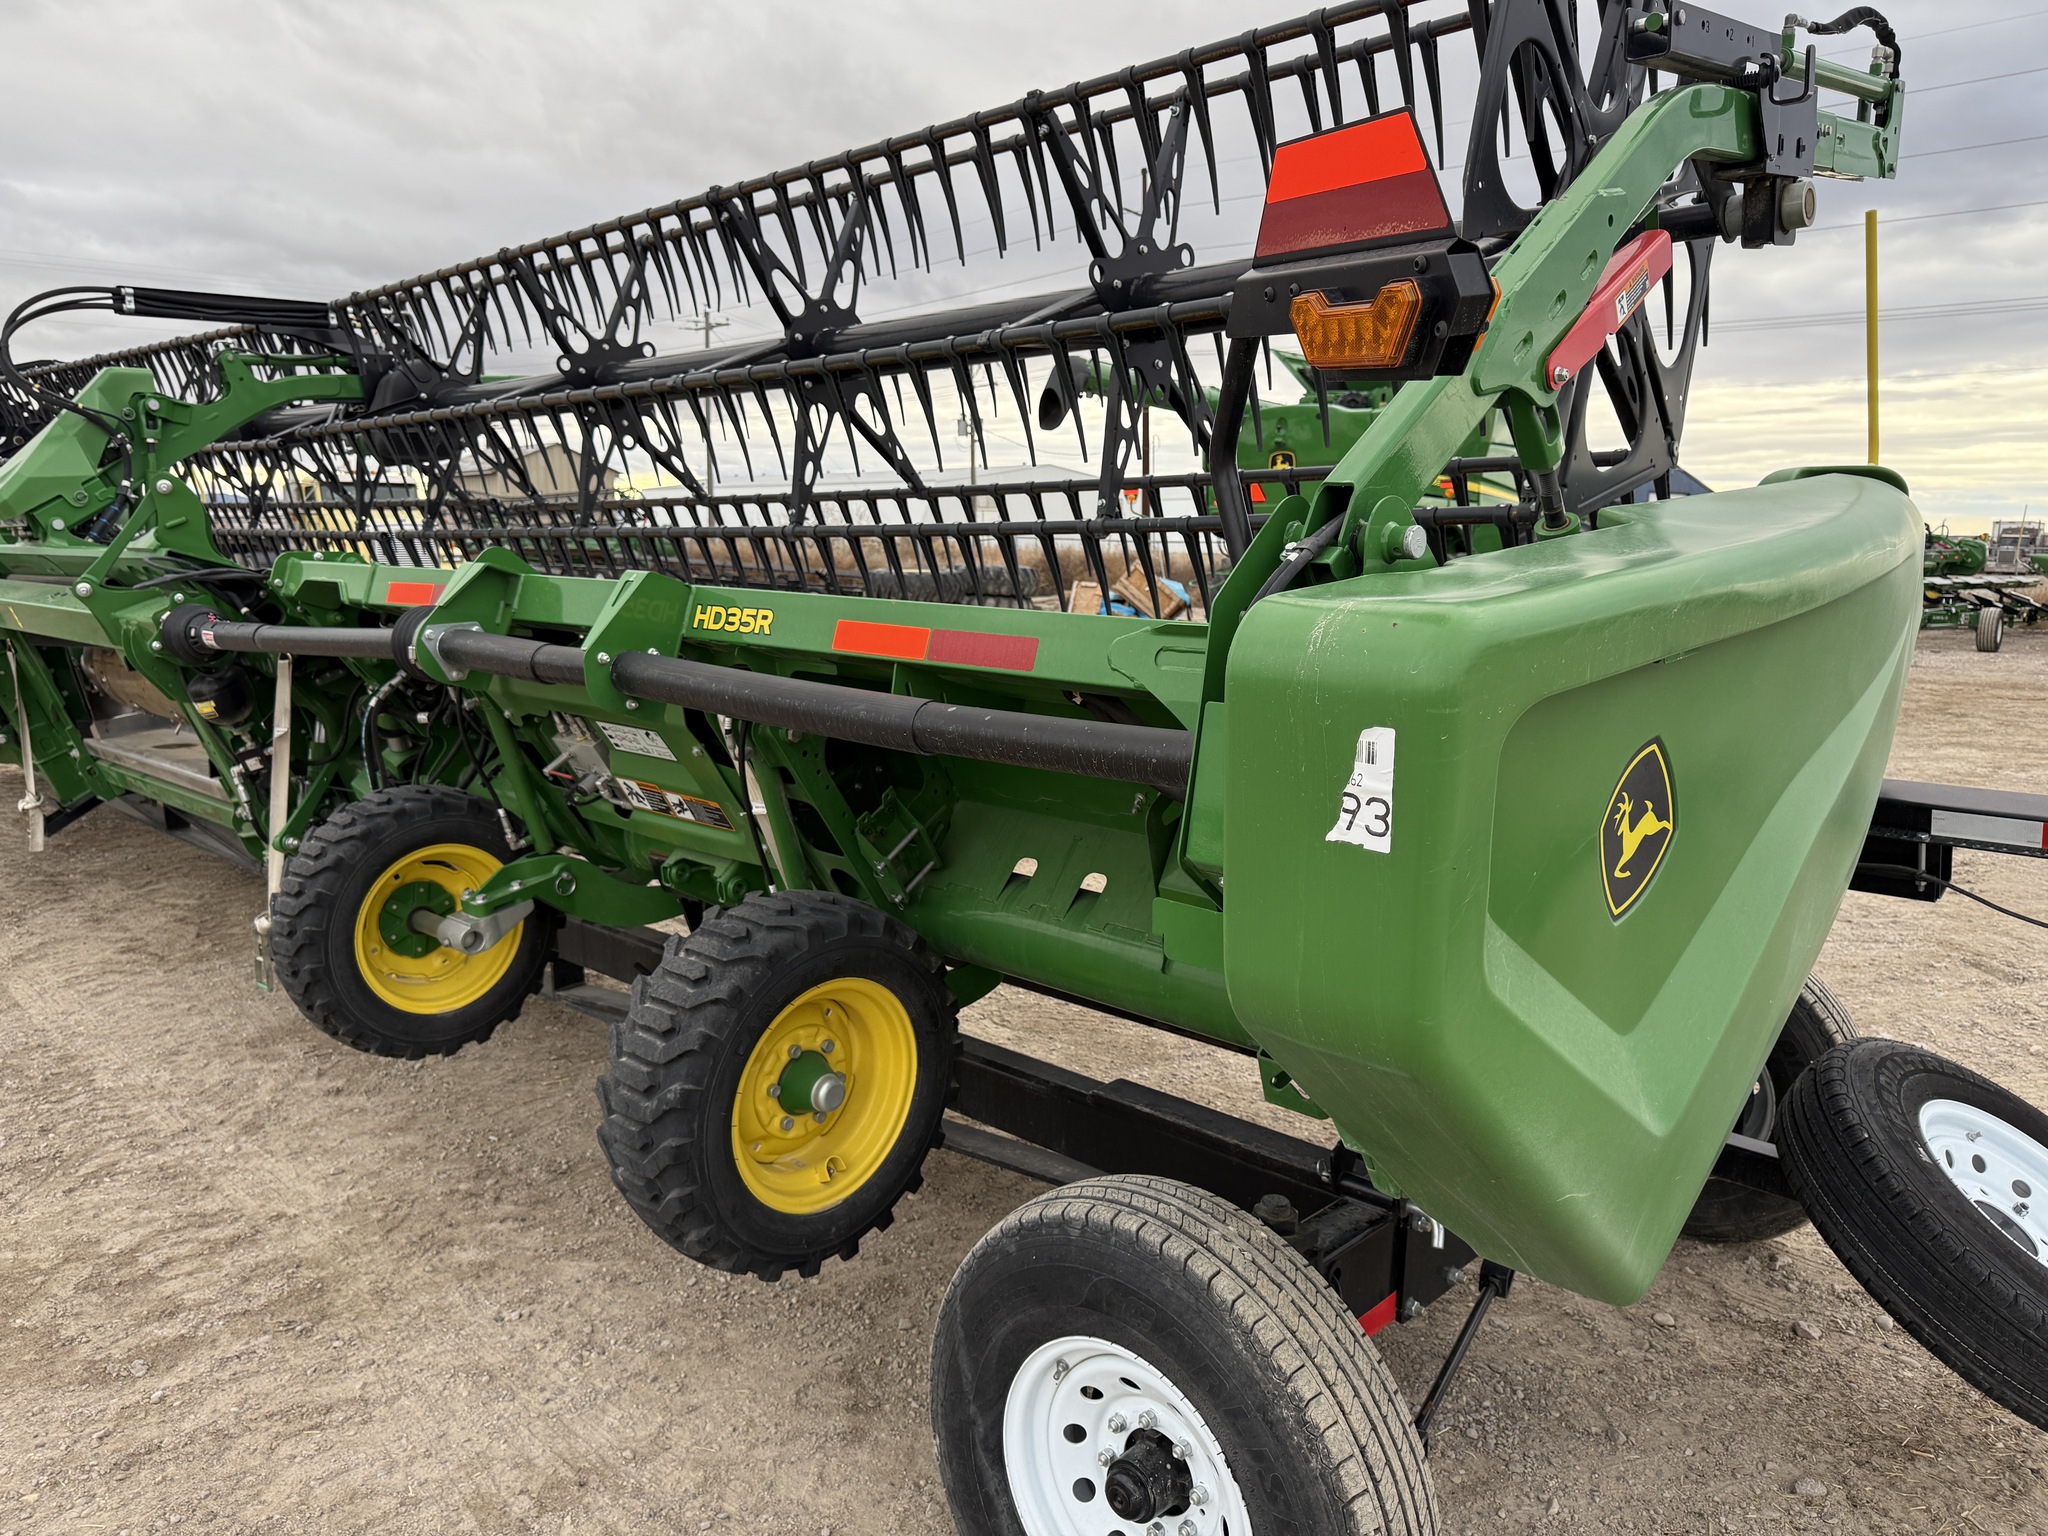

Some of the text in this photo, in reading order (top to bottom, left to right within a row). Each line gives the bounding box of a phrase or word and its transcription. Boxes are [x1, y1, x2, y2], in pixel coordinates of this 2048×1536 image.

[1705, 20, 1710, 33] 3
[1729, 28, 1734, 41] 2
[692, 603, 774, 635] HD35R
[1342, 791, 1390, 837] 93
